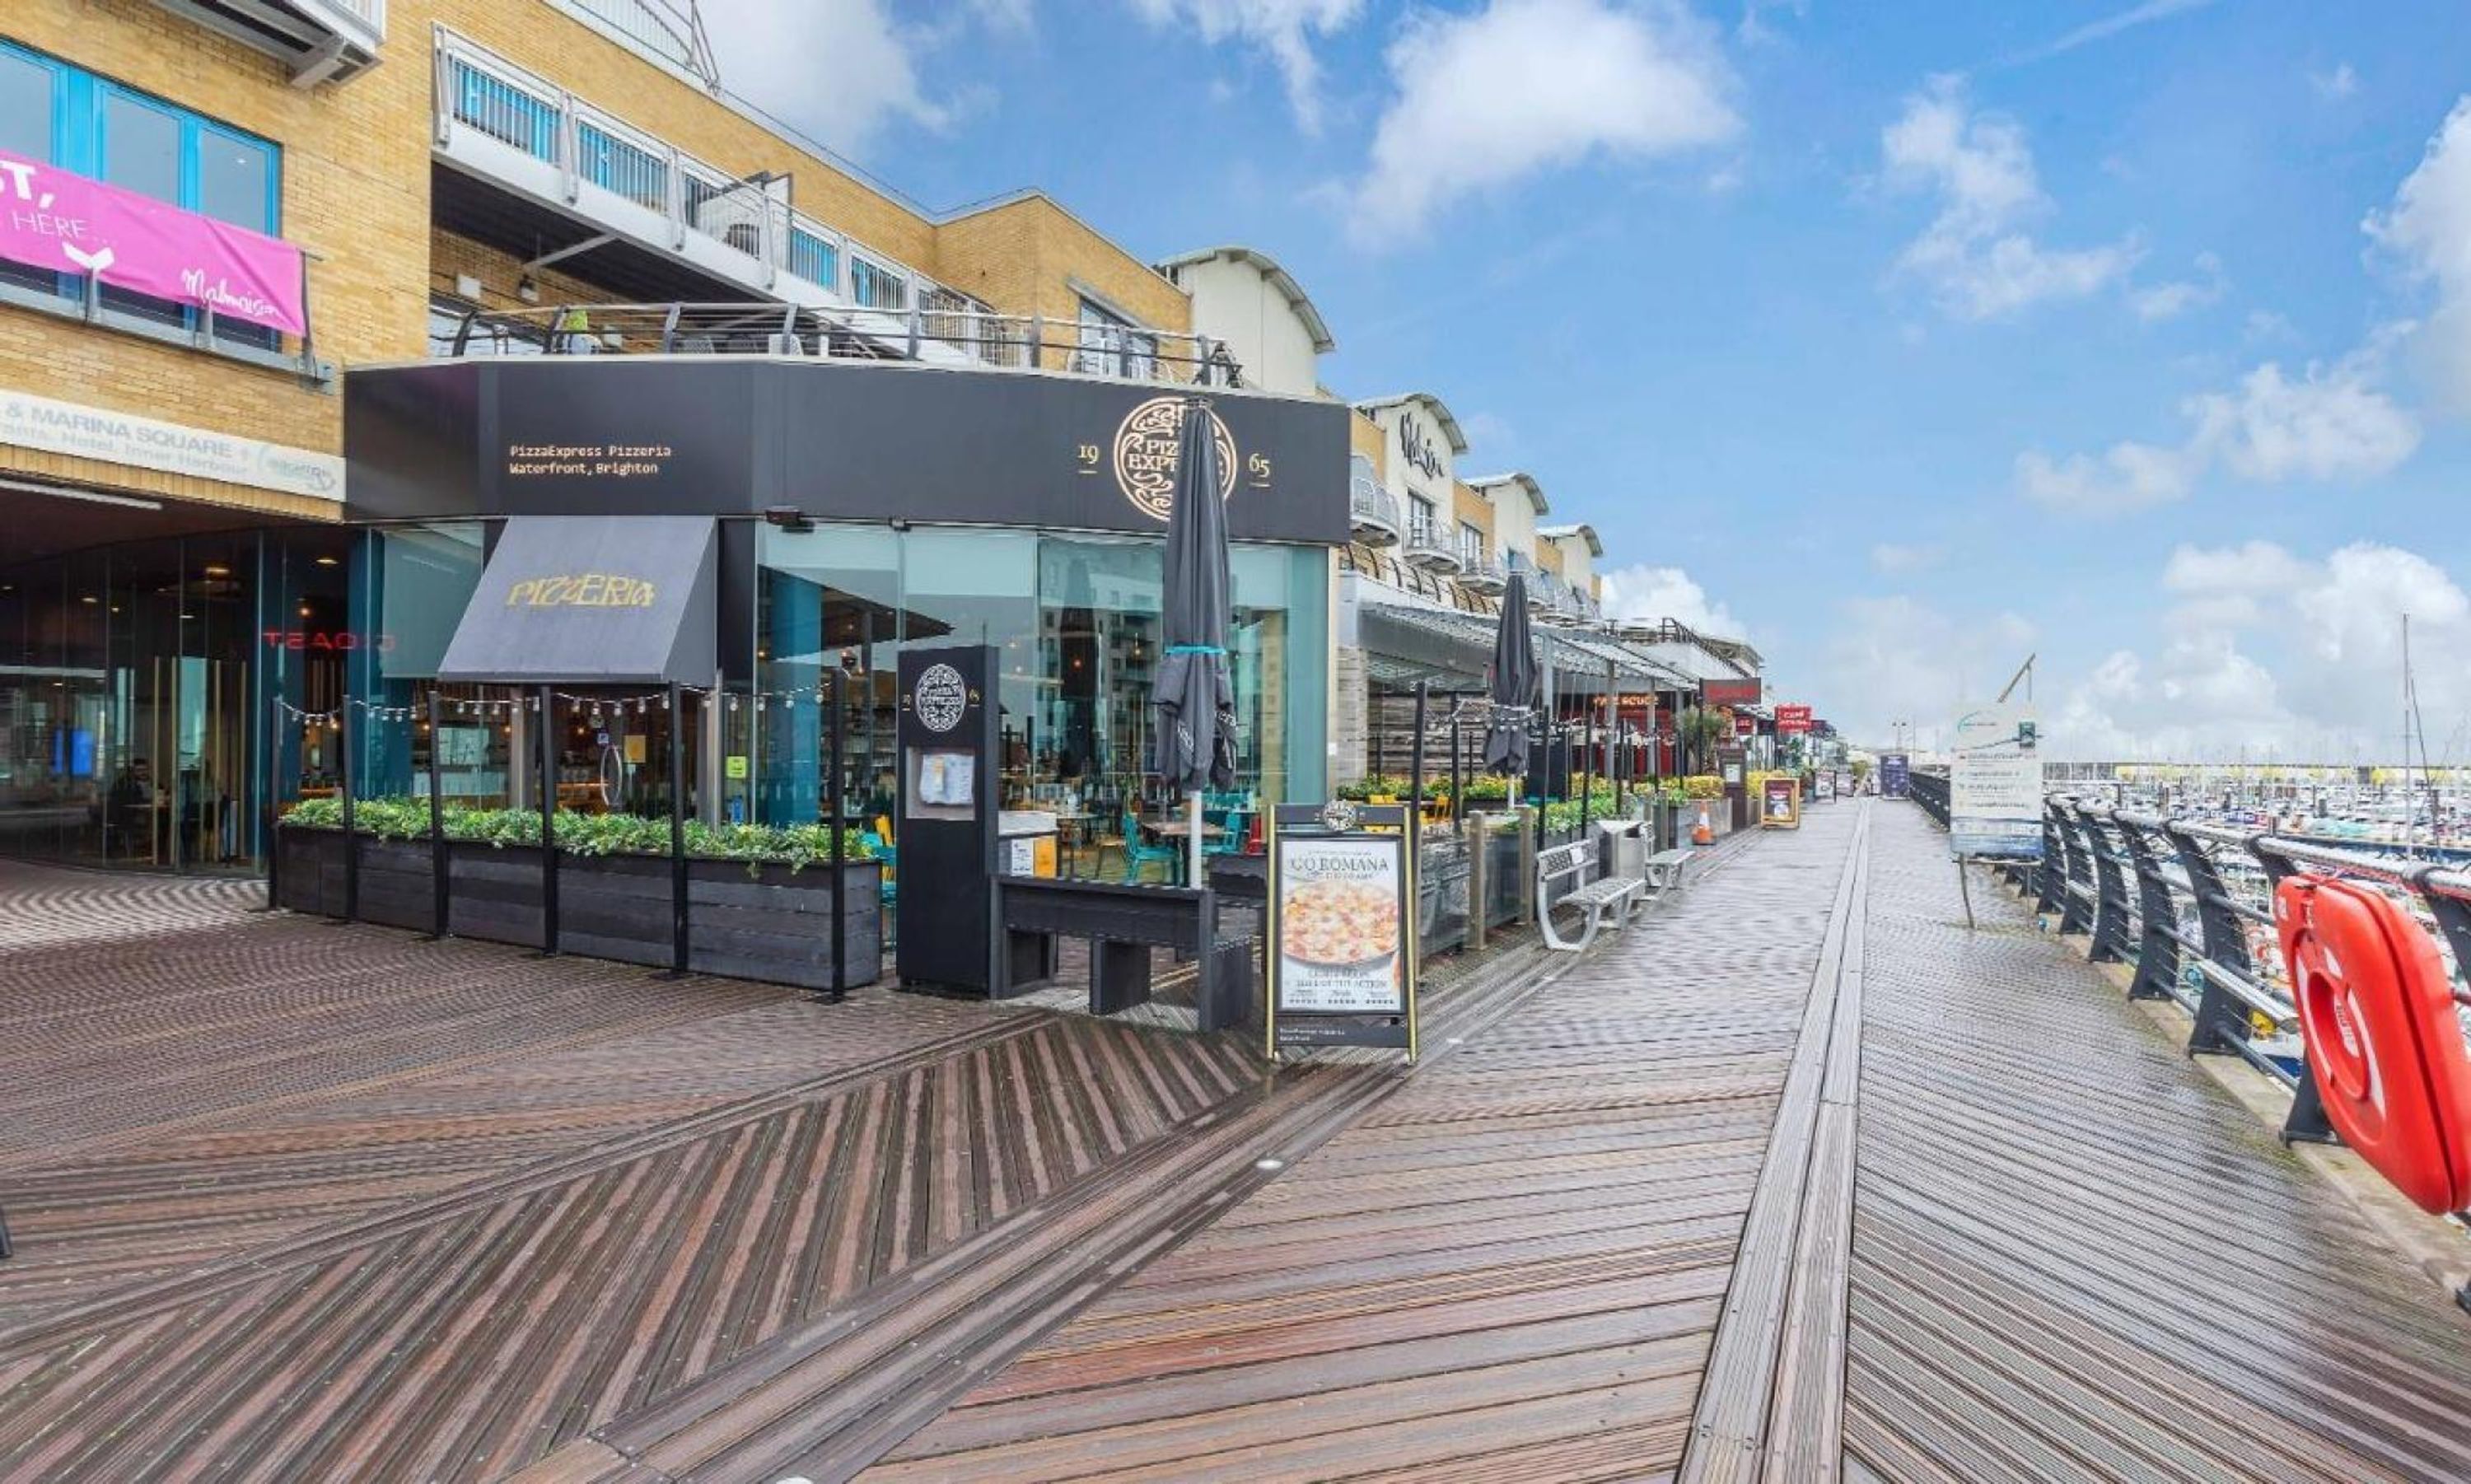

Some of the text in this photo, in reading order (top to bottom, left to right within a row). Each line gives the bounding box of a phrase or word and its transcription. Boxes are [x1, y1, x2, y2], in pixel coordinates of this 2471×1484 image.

[0, 161, 54, 208] T,
[5, 401, 233, 459] & MARINA SQUARE
[510, 445, 671, 460] PizzaExpress Pizzeria
[1078, 445, 1100, 464] 19
[509, 462, 658, 477] Waterfront, Brighton
[1249, 452, 1271, 478] 65
[507, 573, 656, 607] PIZZERIA
[1320, 856, 1390, 871] ROMANA
